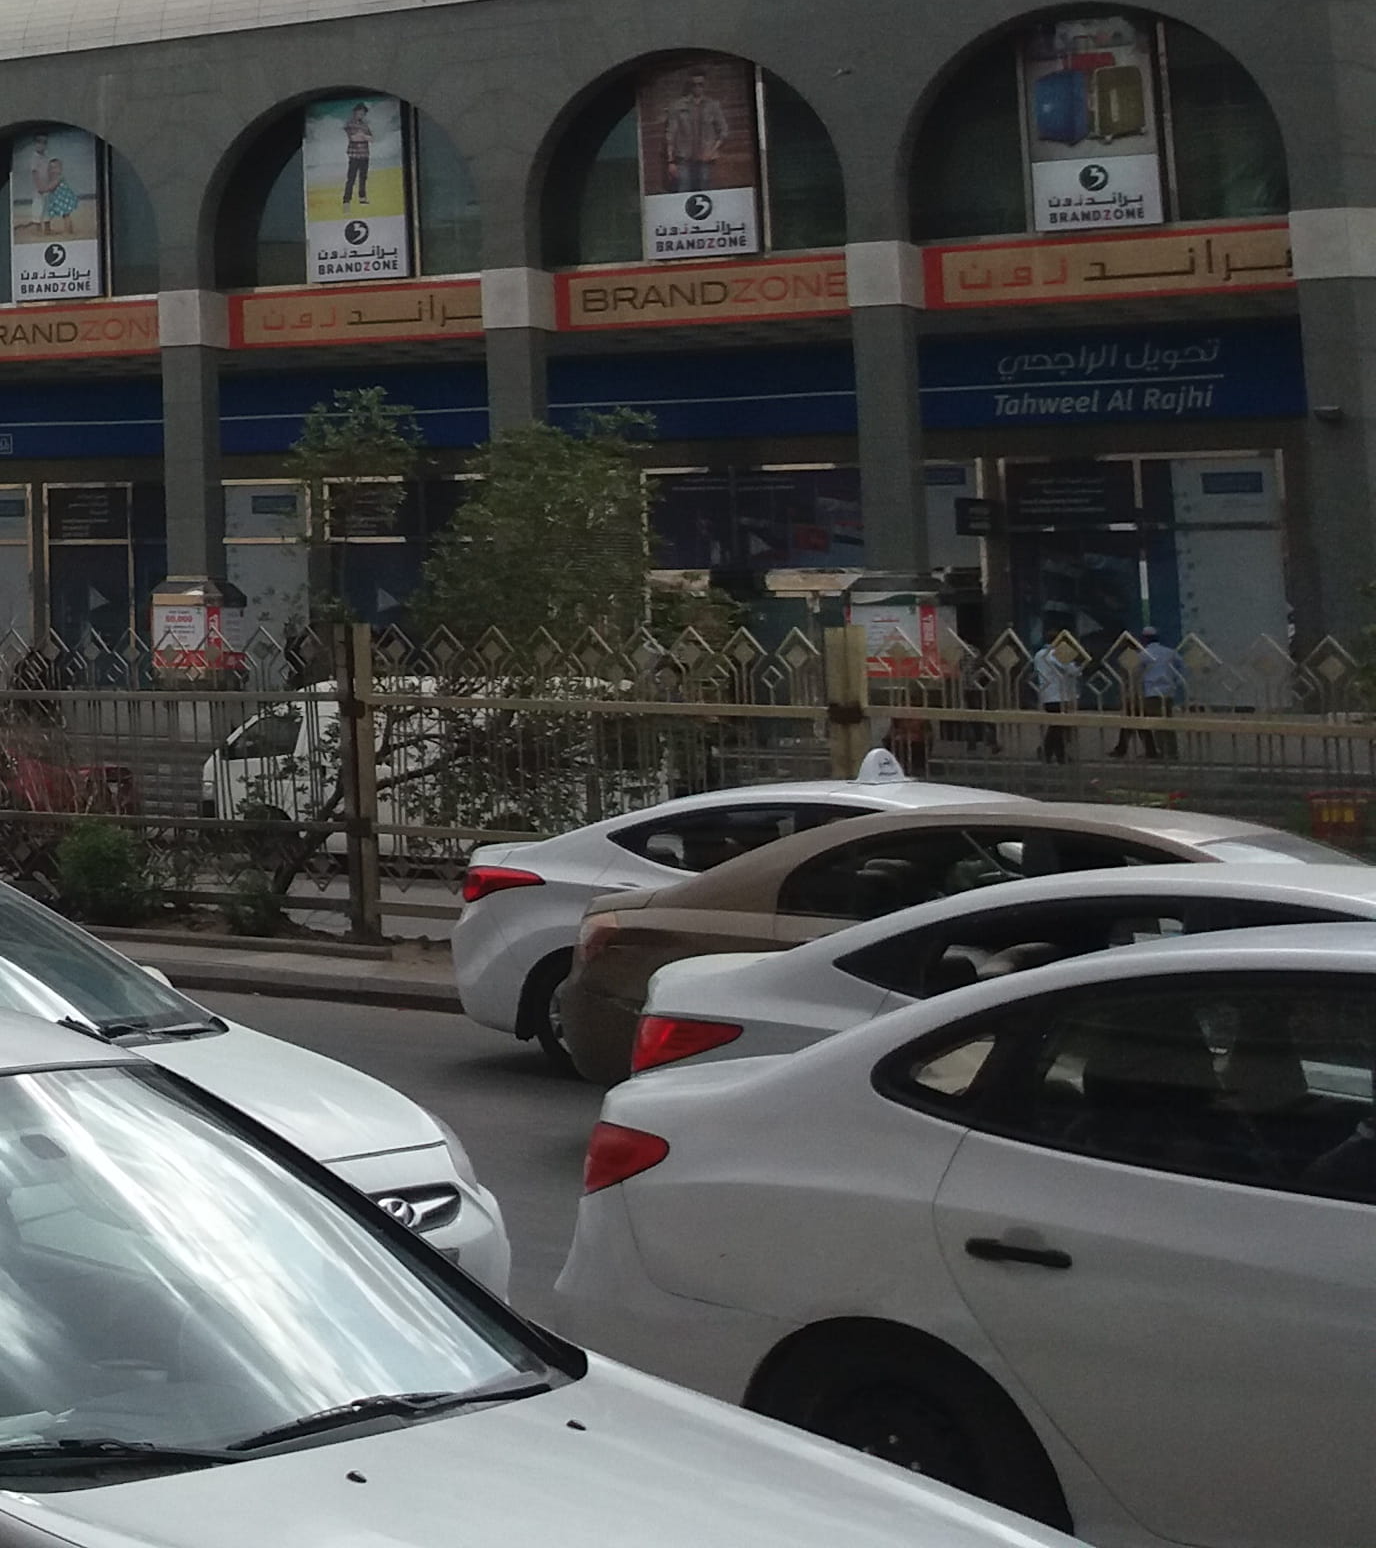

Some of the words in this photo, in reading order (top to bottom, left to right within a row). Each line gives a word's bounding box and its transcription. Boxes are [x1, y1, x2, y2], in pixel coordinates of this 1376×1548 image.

[1048, 207, 1145, 224] BRANDZONE
[656, 236, 746, 253] BRANDZONE
[318, 260, 398, 275] BRANDZONE
[20, 281, 91, 294] BRANDZONE
[582, 271, 847, 313] BRANDZONE
[998, 343, 1119, 382] الراجحي
[1125, 338, 1222, 372] تحويل
[994, 390, 1100, 416] Tahweel
[1106, 388, 1134, 412] Al
[1143, 384, 1215, 415] Rajhi
